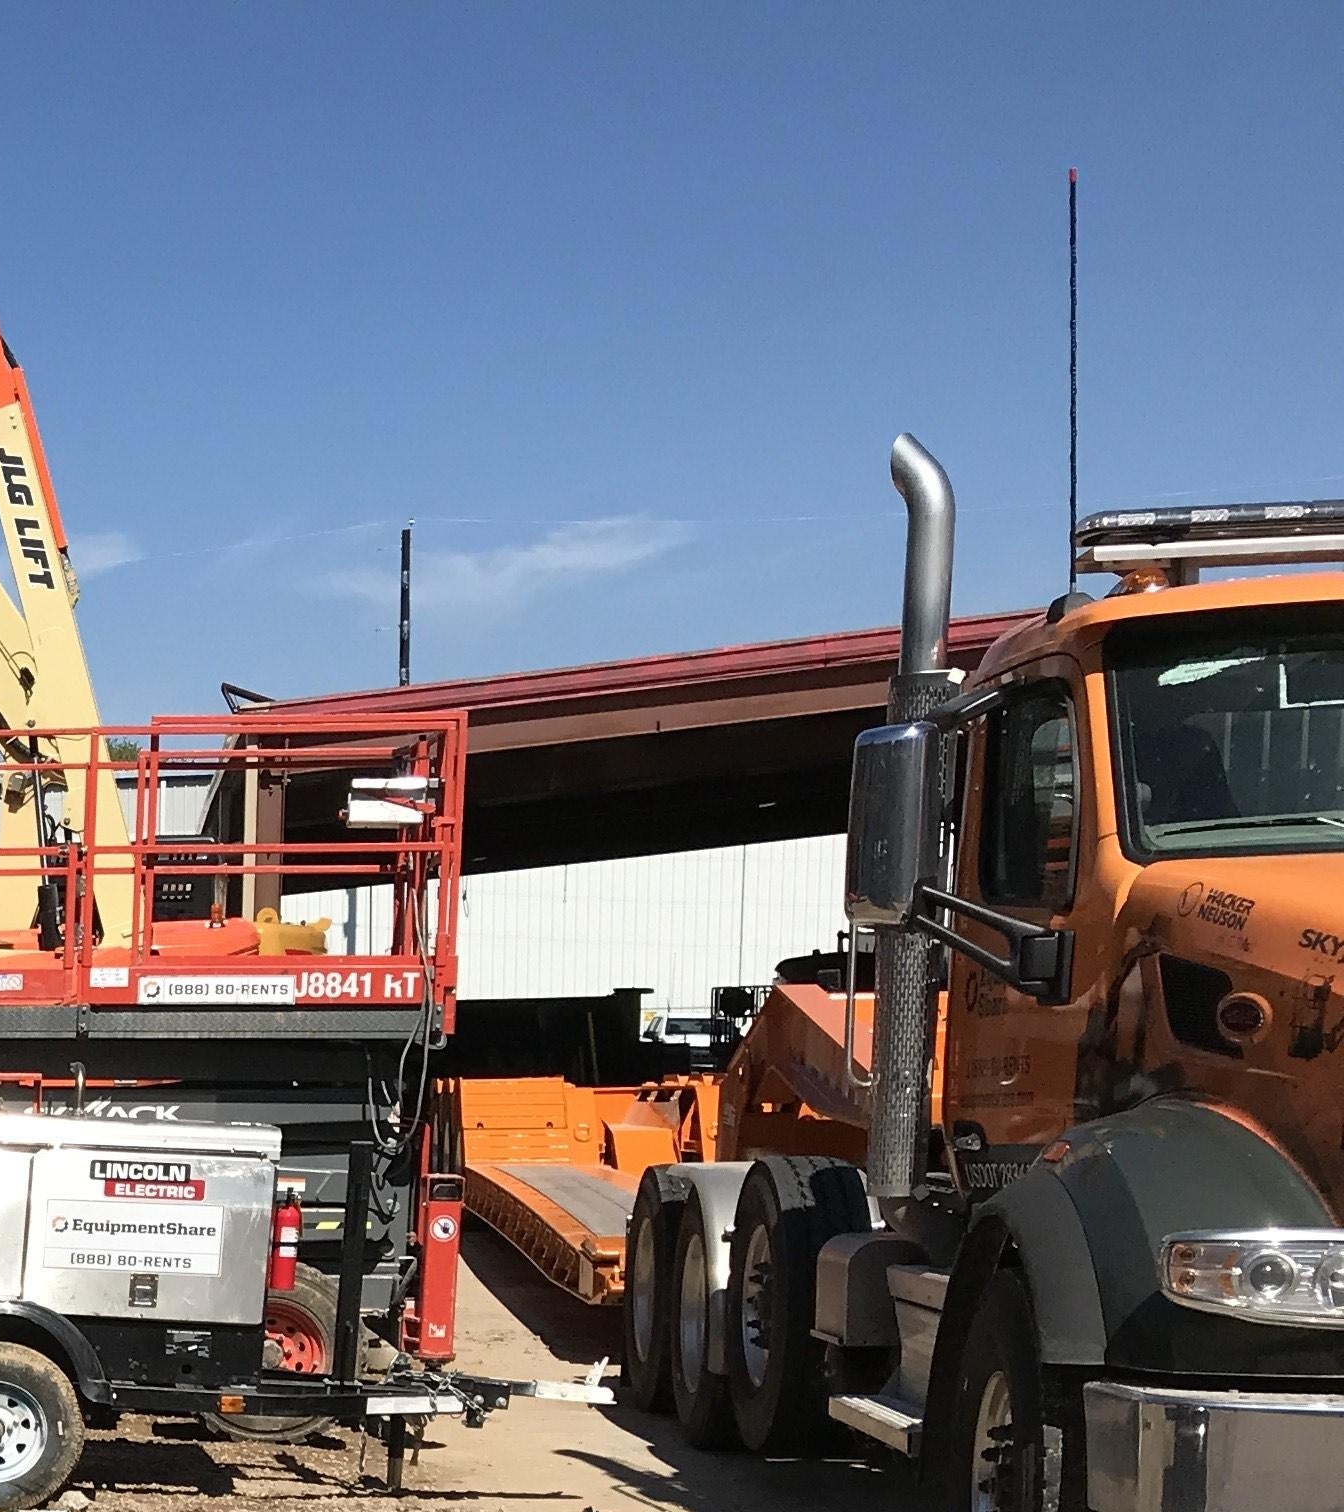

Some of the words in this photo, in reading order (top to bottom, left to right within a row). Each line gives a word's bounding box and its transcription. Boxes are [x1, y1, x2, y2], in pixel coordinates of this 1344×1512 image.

[14, 518, 55, 590] LIFT
[1197, 904, 1248, 931] NEUSON
[168, 984, 210, 997] (888)
[215, 984, 289, 996] 80-RENTS
[94, 1162, 186, 1182] LINCOLN
[965, 1163, 999, 1188] USDOT
[114, 1184, 196, 1199] ELECTRIC
[72, 1219, 216, 1236] EquipmentShare
[70, 1252, 112, 1266] (888)
[117, 1255, 192, 1269] 80-RENTS
